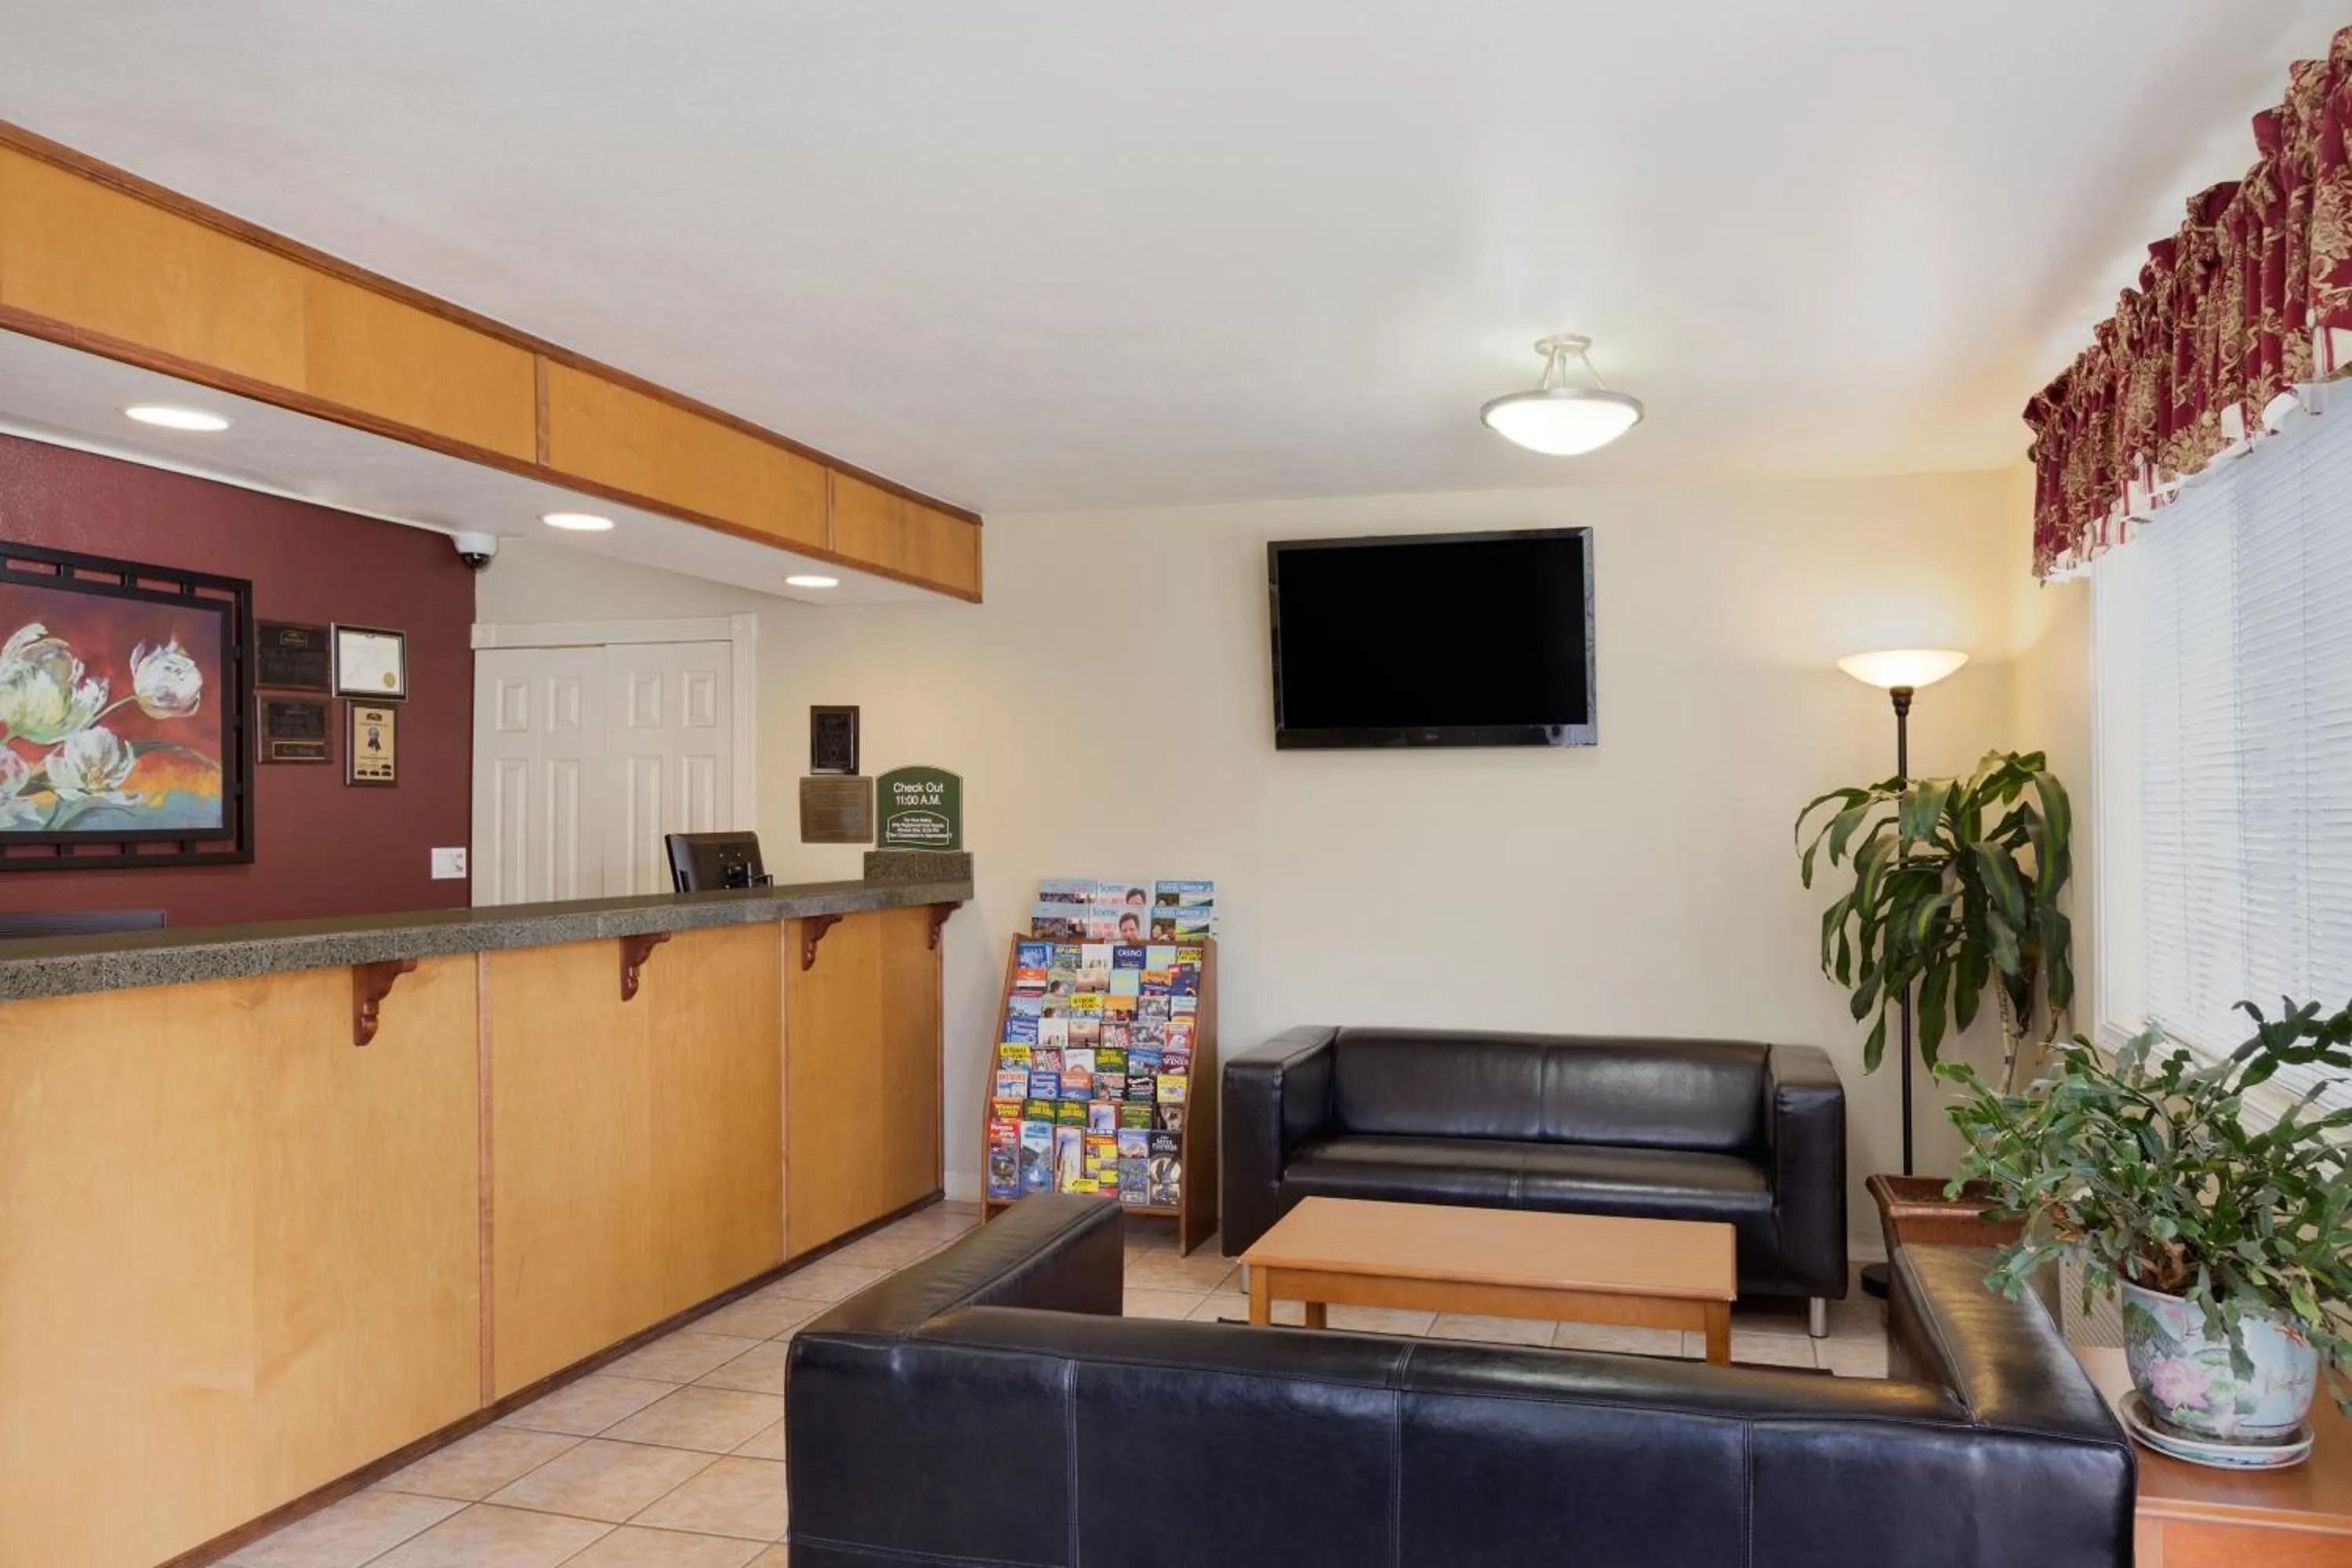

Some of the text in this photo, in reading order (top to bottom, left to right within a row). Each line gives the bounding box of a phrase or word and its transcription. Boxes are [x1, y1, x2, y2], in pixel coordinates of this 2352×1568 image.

[894, 782, 944, 792] Check Out
[896, 795, 942, 805] 11:00 A.M.
